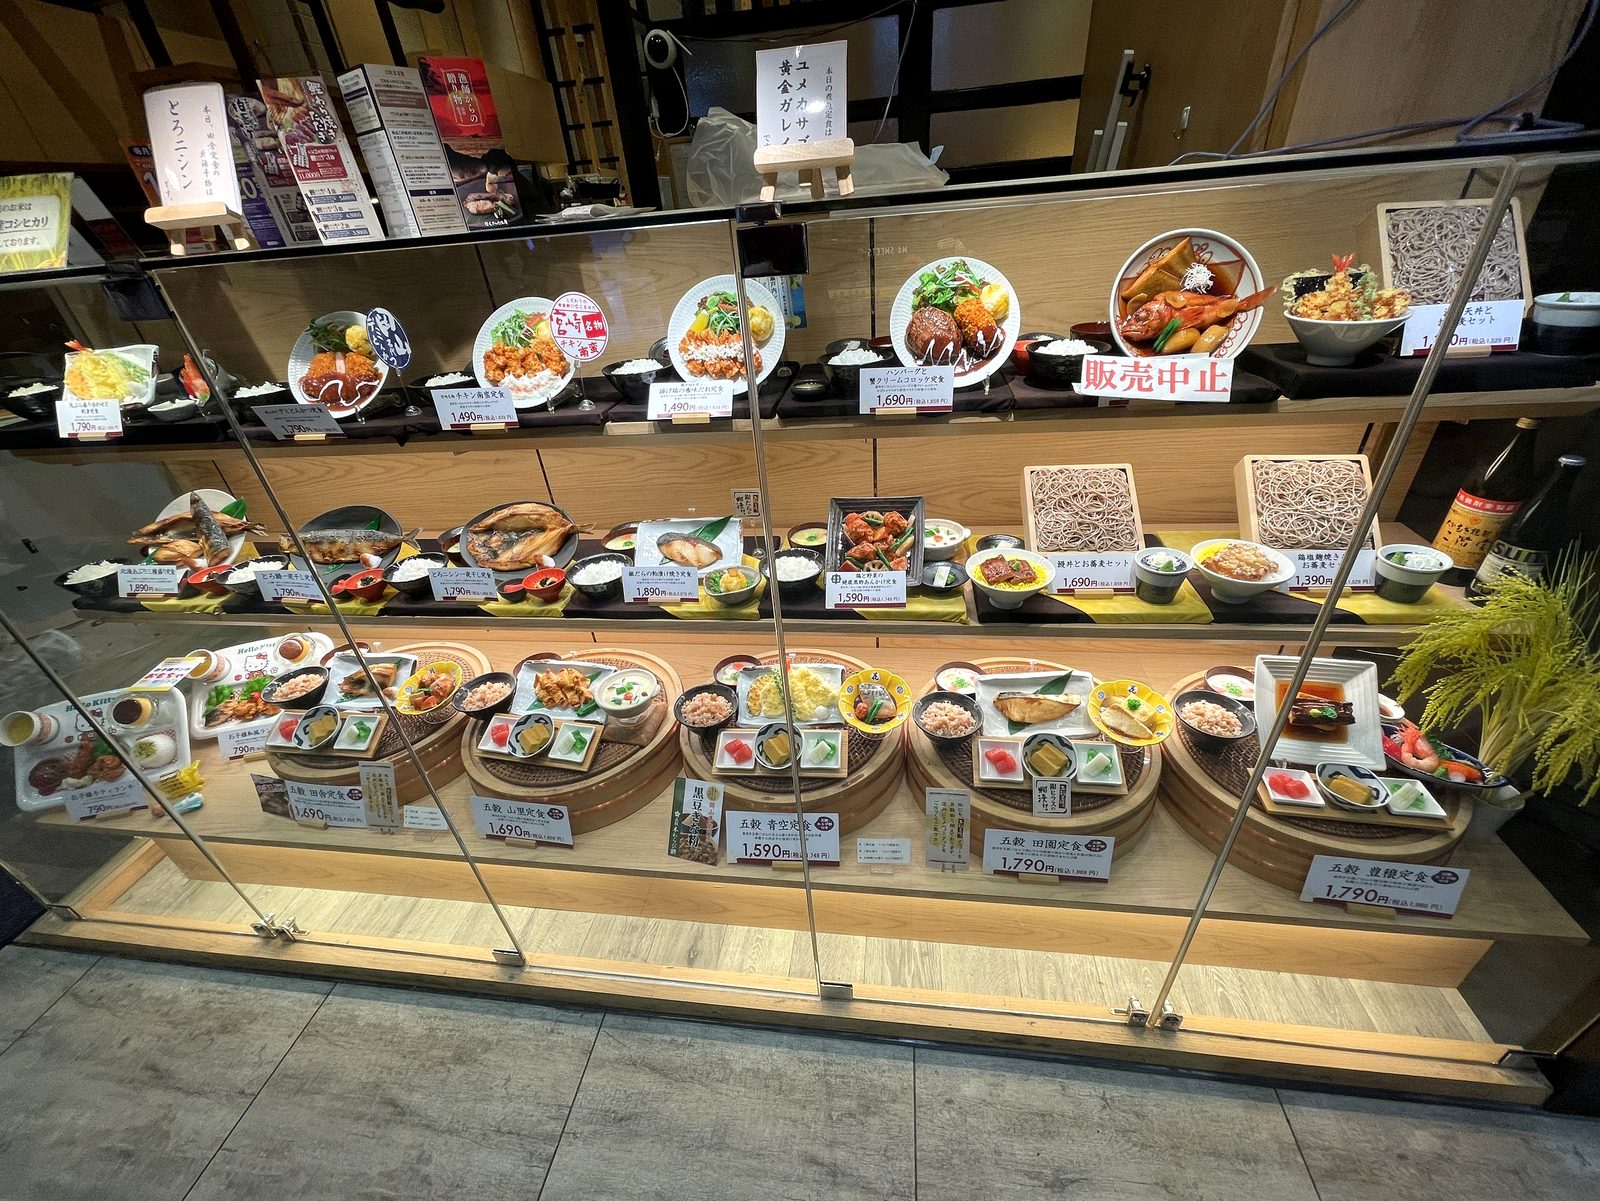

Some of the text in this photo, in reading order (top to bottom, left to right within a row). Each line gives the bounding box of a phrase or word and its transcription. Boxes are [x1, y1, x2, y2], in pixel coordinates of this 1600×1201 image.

[447, 73, 463, 105] 贈り物
[458, 73, 478, 123] 漁師からの
[168, 99, 192, 189] とろニシン
[1443, 304, 1493, 317] 天丼と
[550, 308, 603, 336] 宮崎 名物
[1438, 315, 1495, 326] 麦セット
[1423, 333, 1468, 349] 1,0円
[561, 340, 599, 357] チキン 南蛮
[886, 368, 927, 376] ハンバーグと
[1084, 359, 1229, 394] 販売中止
[869, 375, 945, 385] 蟹クリームコロッケ定食
[456, 390, 505, 399] チキン南蛮定食
[876, 394, 913, 407] 1,690円
[663, 402, 696, 413] 1,490円
[451, 411, 483, 423] 1,490円
[71, 422, 97, 432] 1,790円
[1057, 559, 1129, 568] 鰻丼とお蕎麦セット
[1298, 553, 1345, 562] 鶏塩麹焼き
[1302, 561, 1341, 569] お蕎麦セ
[431, 571, 492, 579] とろニシン一夜干し定食
[1295, 575, 1333, 586] 1,390円
[129, 584, 154, 592] 1,890円
[1063, 577, 1098, 588] 1,690円
[274, 588, 301, 597] 1,790円
[444, 586, 471, 596] 1,790円
[636, 587, 667, 597] 1,890円
[838, 593, 870, 603] 1,590円
[237, 646, 260, 654] Hello
[233, 745, 256, 755] 790円
[290, 786, 307, 797] 五穀
[310, 789, 346, 800] 田舎定食
[87, 804, 113, 815] 790円
[295, 805, 332, 820] 1,690円
[483, 803, 502, 813] 五穀
[507, 806, 546, 819] 山里定食
[688, 786, 704, 847] 黒豆きな粉
[489, 822, 530, 838] 1,690円
[740, 818, 762, 831] 五穀
[767, 819, 812, 831] 青空定食
[1000, 836, 1026, 848] 五穀
[1032, 839, 1083, 851] 田園定食
[743, 843, 791, 858] 1,590円
[1001, 856, 1054, 873] 1,790円
[1328, 863, 1360, 876] 五穀
[1366, 866, 1429, 883] 豊穣定食
[1324, 885, 1389, 904] 1,790円
